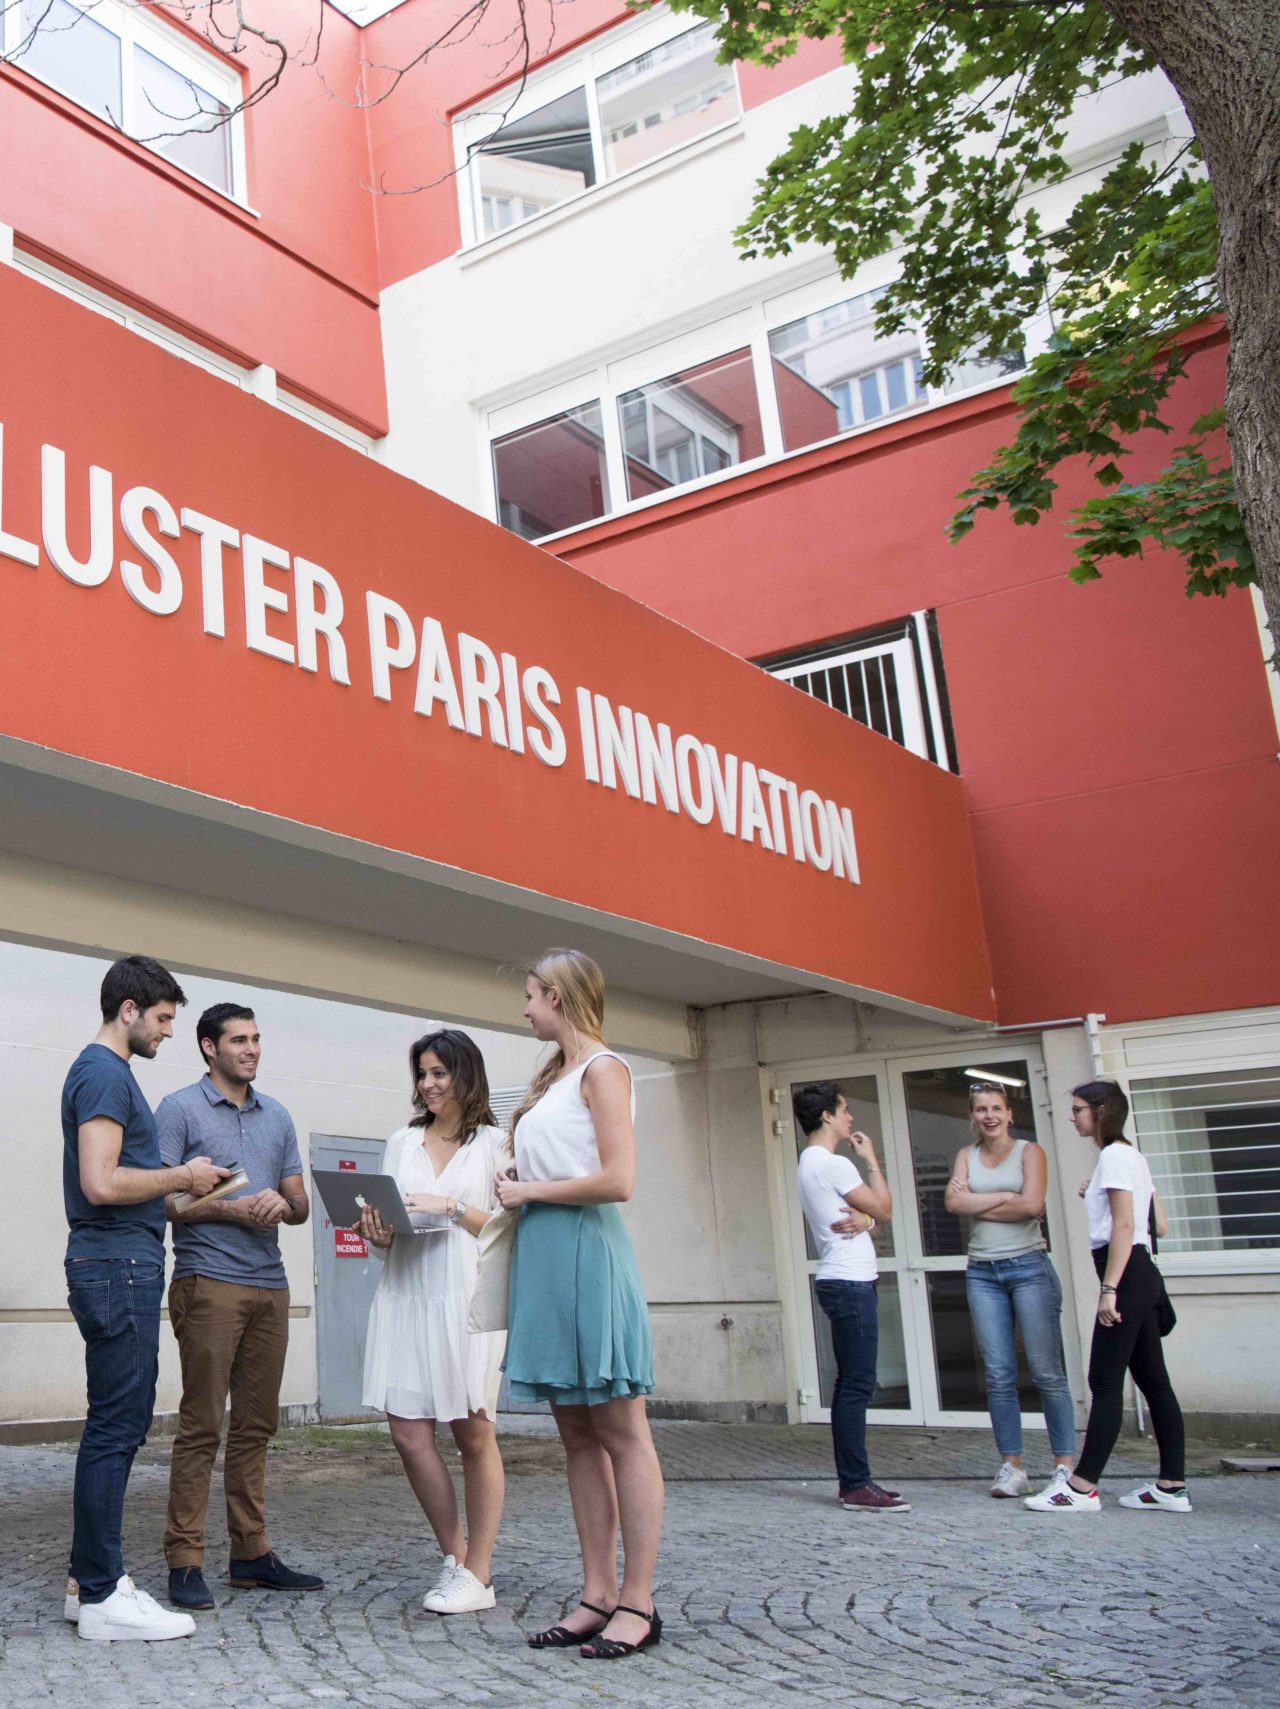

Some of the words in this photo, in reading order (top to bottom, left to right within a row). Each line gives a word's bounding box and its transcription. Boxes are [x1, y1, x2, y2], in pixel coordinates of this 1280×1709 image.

[366, 590, 567, 768] PARIS
[576, 686, 860, 885] INNOVATION
[343, 1233, 360, 1242] TOUR
[336, 1245, 363, 1253] INCENDIE
